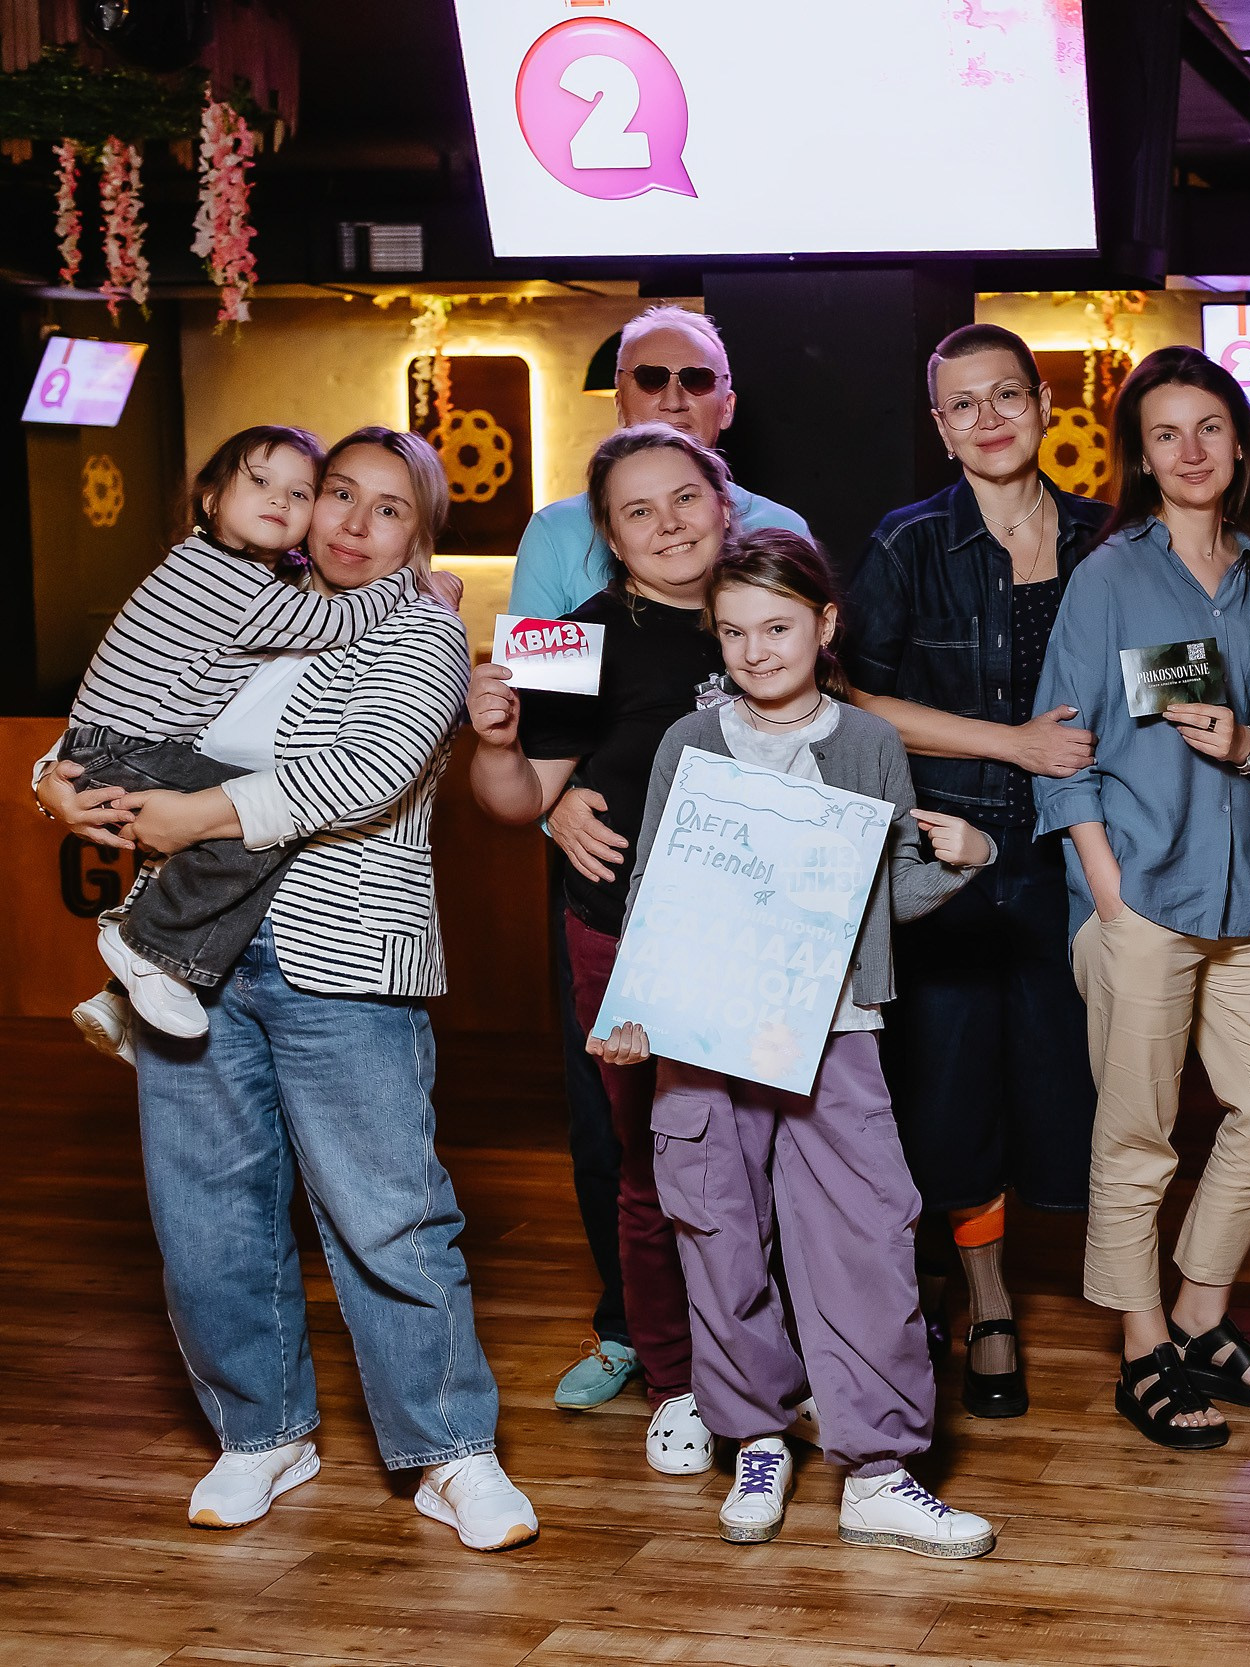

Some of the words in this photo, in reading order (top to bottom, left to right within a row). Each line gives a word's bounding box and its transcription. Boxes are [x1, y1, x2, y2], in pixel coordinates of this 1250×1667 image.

[558, 53, 652, 170] 2
[44, 373, 67, 402] 2
[1136, 662, 1211, 685] PRIKOSNOVENIE
